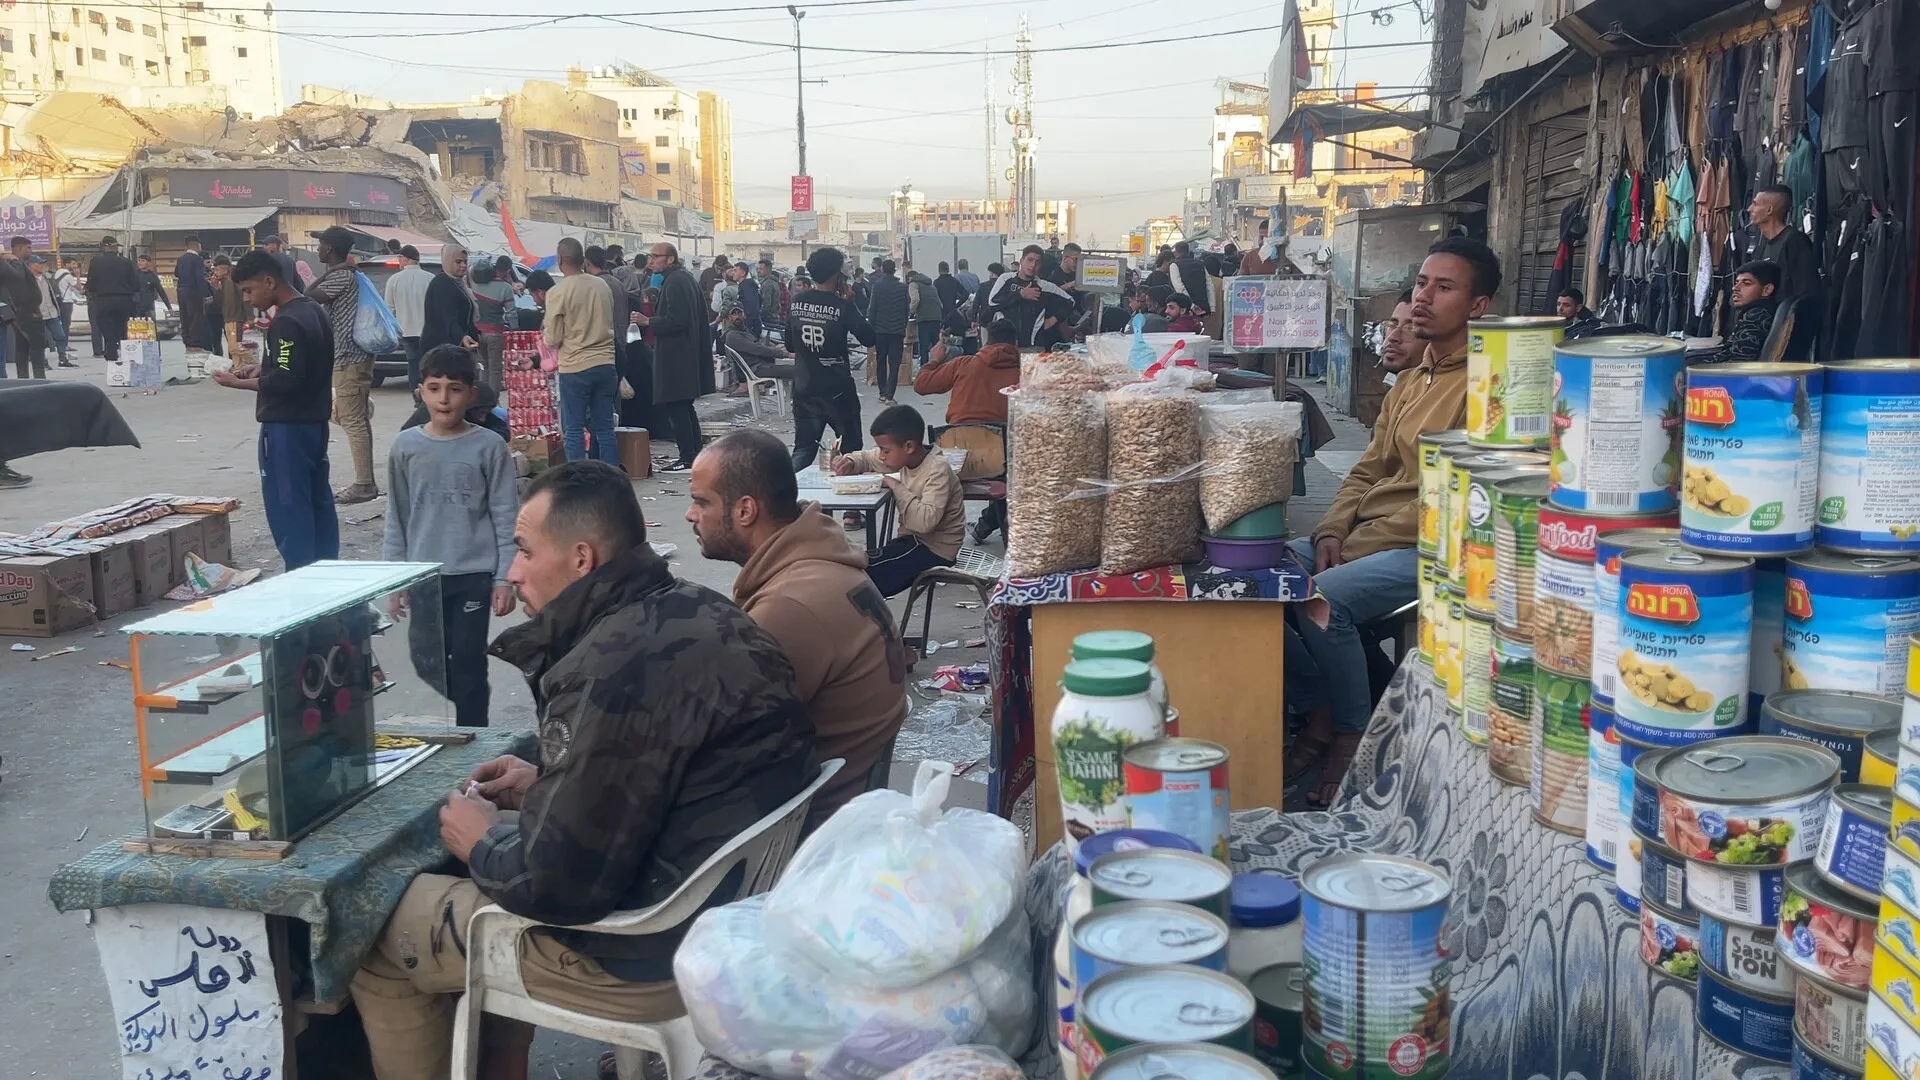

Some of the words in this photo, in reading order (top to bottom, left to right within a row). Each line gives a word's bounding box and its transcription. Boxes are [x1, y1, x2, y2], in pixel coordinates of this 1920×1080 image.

[797, 196, 805, 205] 2
[0, 219, 26, 232] موباي
[28, 218, 46, 230] زين
[790, 302, 840, 316] BALENCIAGA
[1703, 389, 1725, 398] RONA
[7, 572, 33, 590] Day
[0, 589, 28, 602] uccino
[1662, 586, 1689, 596] RONA
[1631, 590, 1687, 616] רונה
[1661, 633, 1706, 646] פטריות
[1683, 731, 1697, 739] 400
[1820, 739, 1852, 751] TUNA
[1064, 748, 1118, 765] SESAME
[1067, 762, 1119, 779] TAHINI
[1732, 935, 1777, 965] Sasu
[1731, 952, 1777, 980] TON
